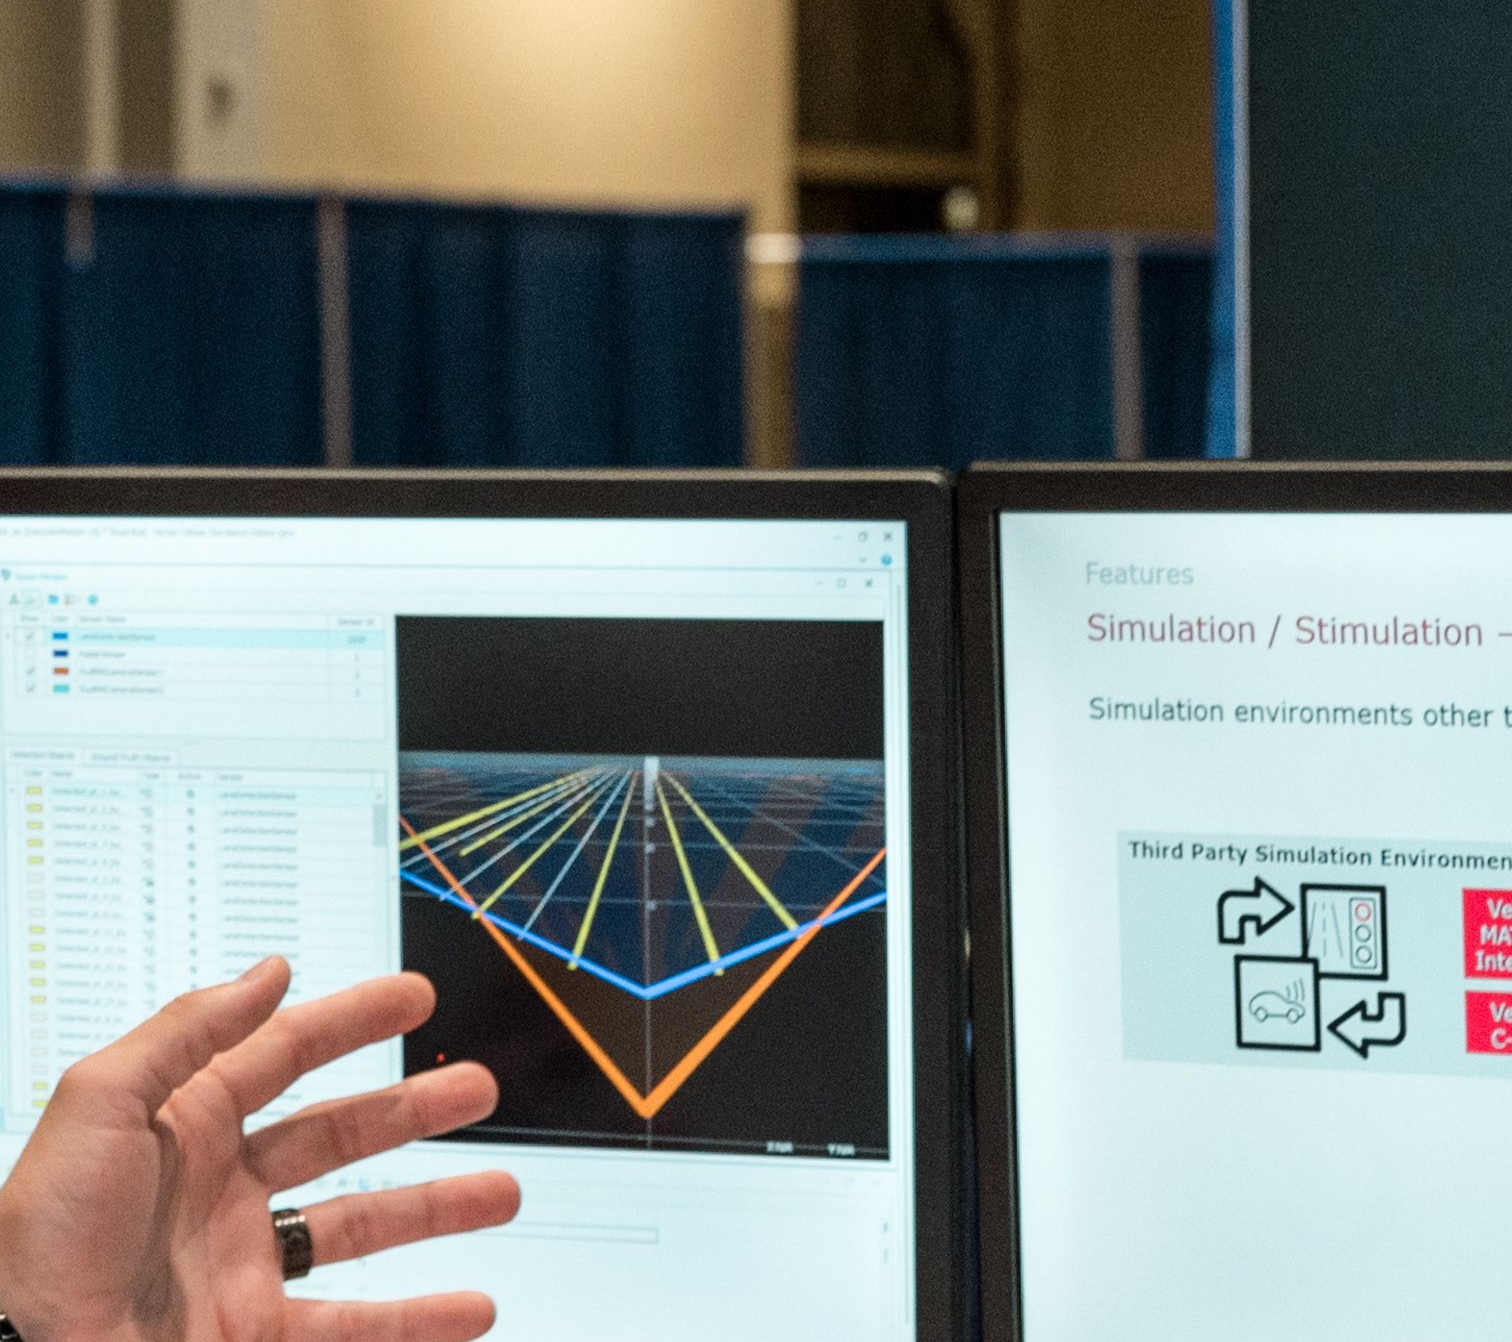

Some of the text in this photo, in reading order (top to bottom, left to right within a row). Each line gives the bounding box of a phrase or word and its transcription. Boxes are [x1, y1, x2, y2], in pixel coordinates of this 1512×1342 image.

[1085, 561, 1194, 587] Features
[1087, 614, 1255, 645] Simulation
[1268, 615, 1280, 649] /
[1295, 615, 1483, 648] Stimulation
[1090, 698, 1224, 725] Simulation
[1235, 701, 1413, 728] environments
[1423, 703, 1494, 729] other
[1128, 840, 1184, 861] Third
[1191, 843, 1248, 866] Party
[1255, 844, 1372, 867] Simulation
